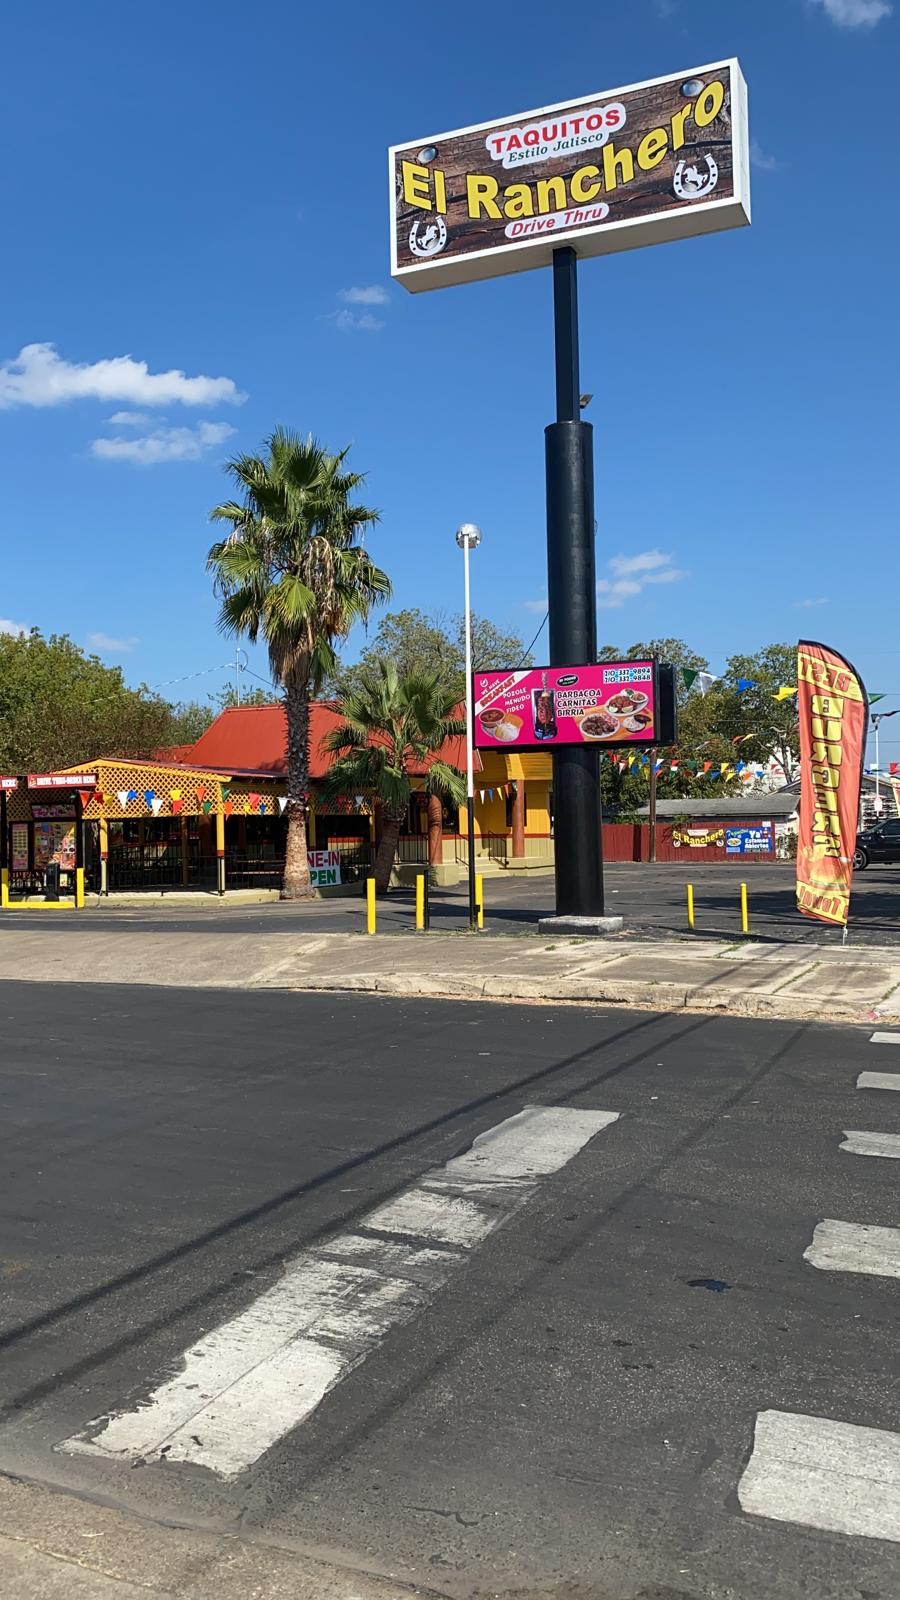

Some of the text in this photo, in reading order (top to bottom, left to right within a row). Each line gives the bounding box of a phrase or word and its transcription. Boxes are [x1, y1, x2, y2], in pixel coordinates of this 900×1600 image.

[491, 109, 621, 154] TAQUITOS
[401, 79, 725, 219] El Ranchero
[507, 131, 604, 163] Estilo Jalisco
[510, 206, 603, 237] Drive Thru
[503, 687, 527, 698] POZOLE
[505, 694, 531, 706] MENUDO
[557, 689, 602, 698] BARBACOA
[506, 703, 525, 714] FIDEO
[557, 699, 597, 707] CARNITAS
[684, 829, 724, 845] Ranchero
[307, 851, 340, 867] NE-IN
[310, 869, 337, 885] PEN
